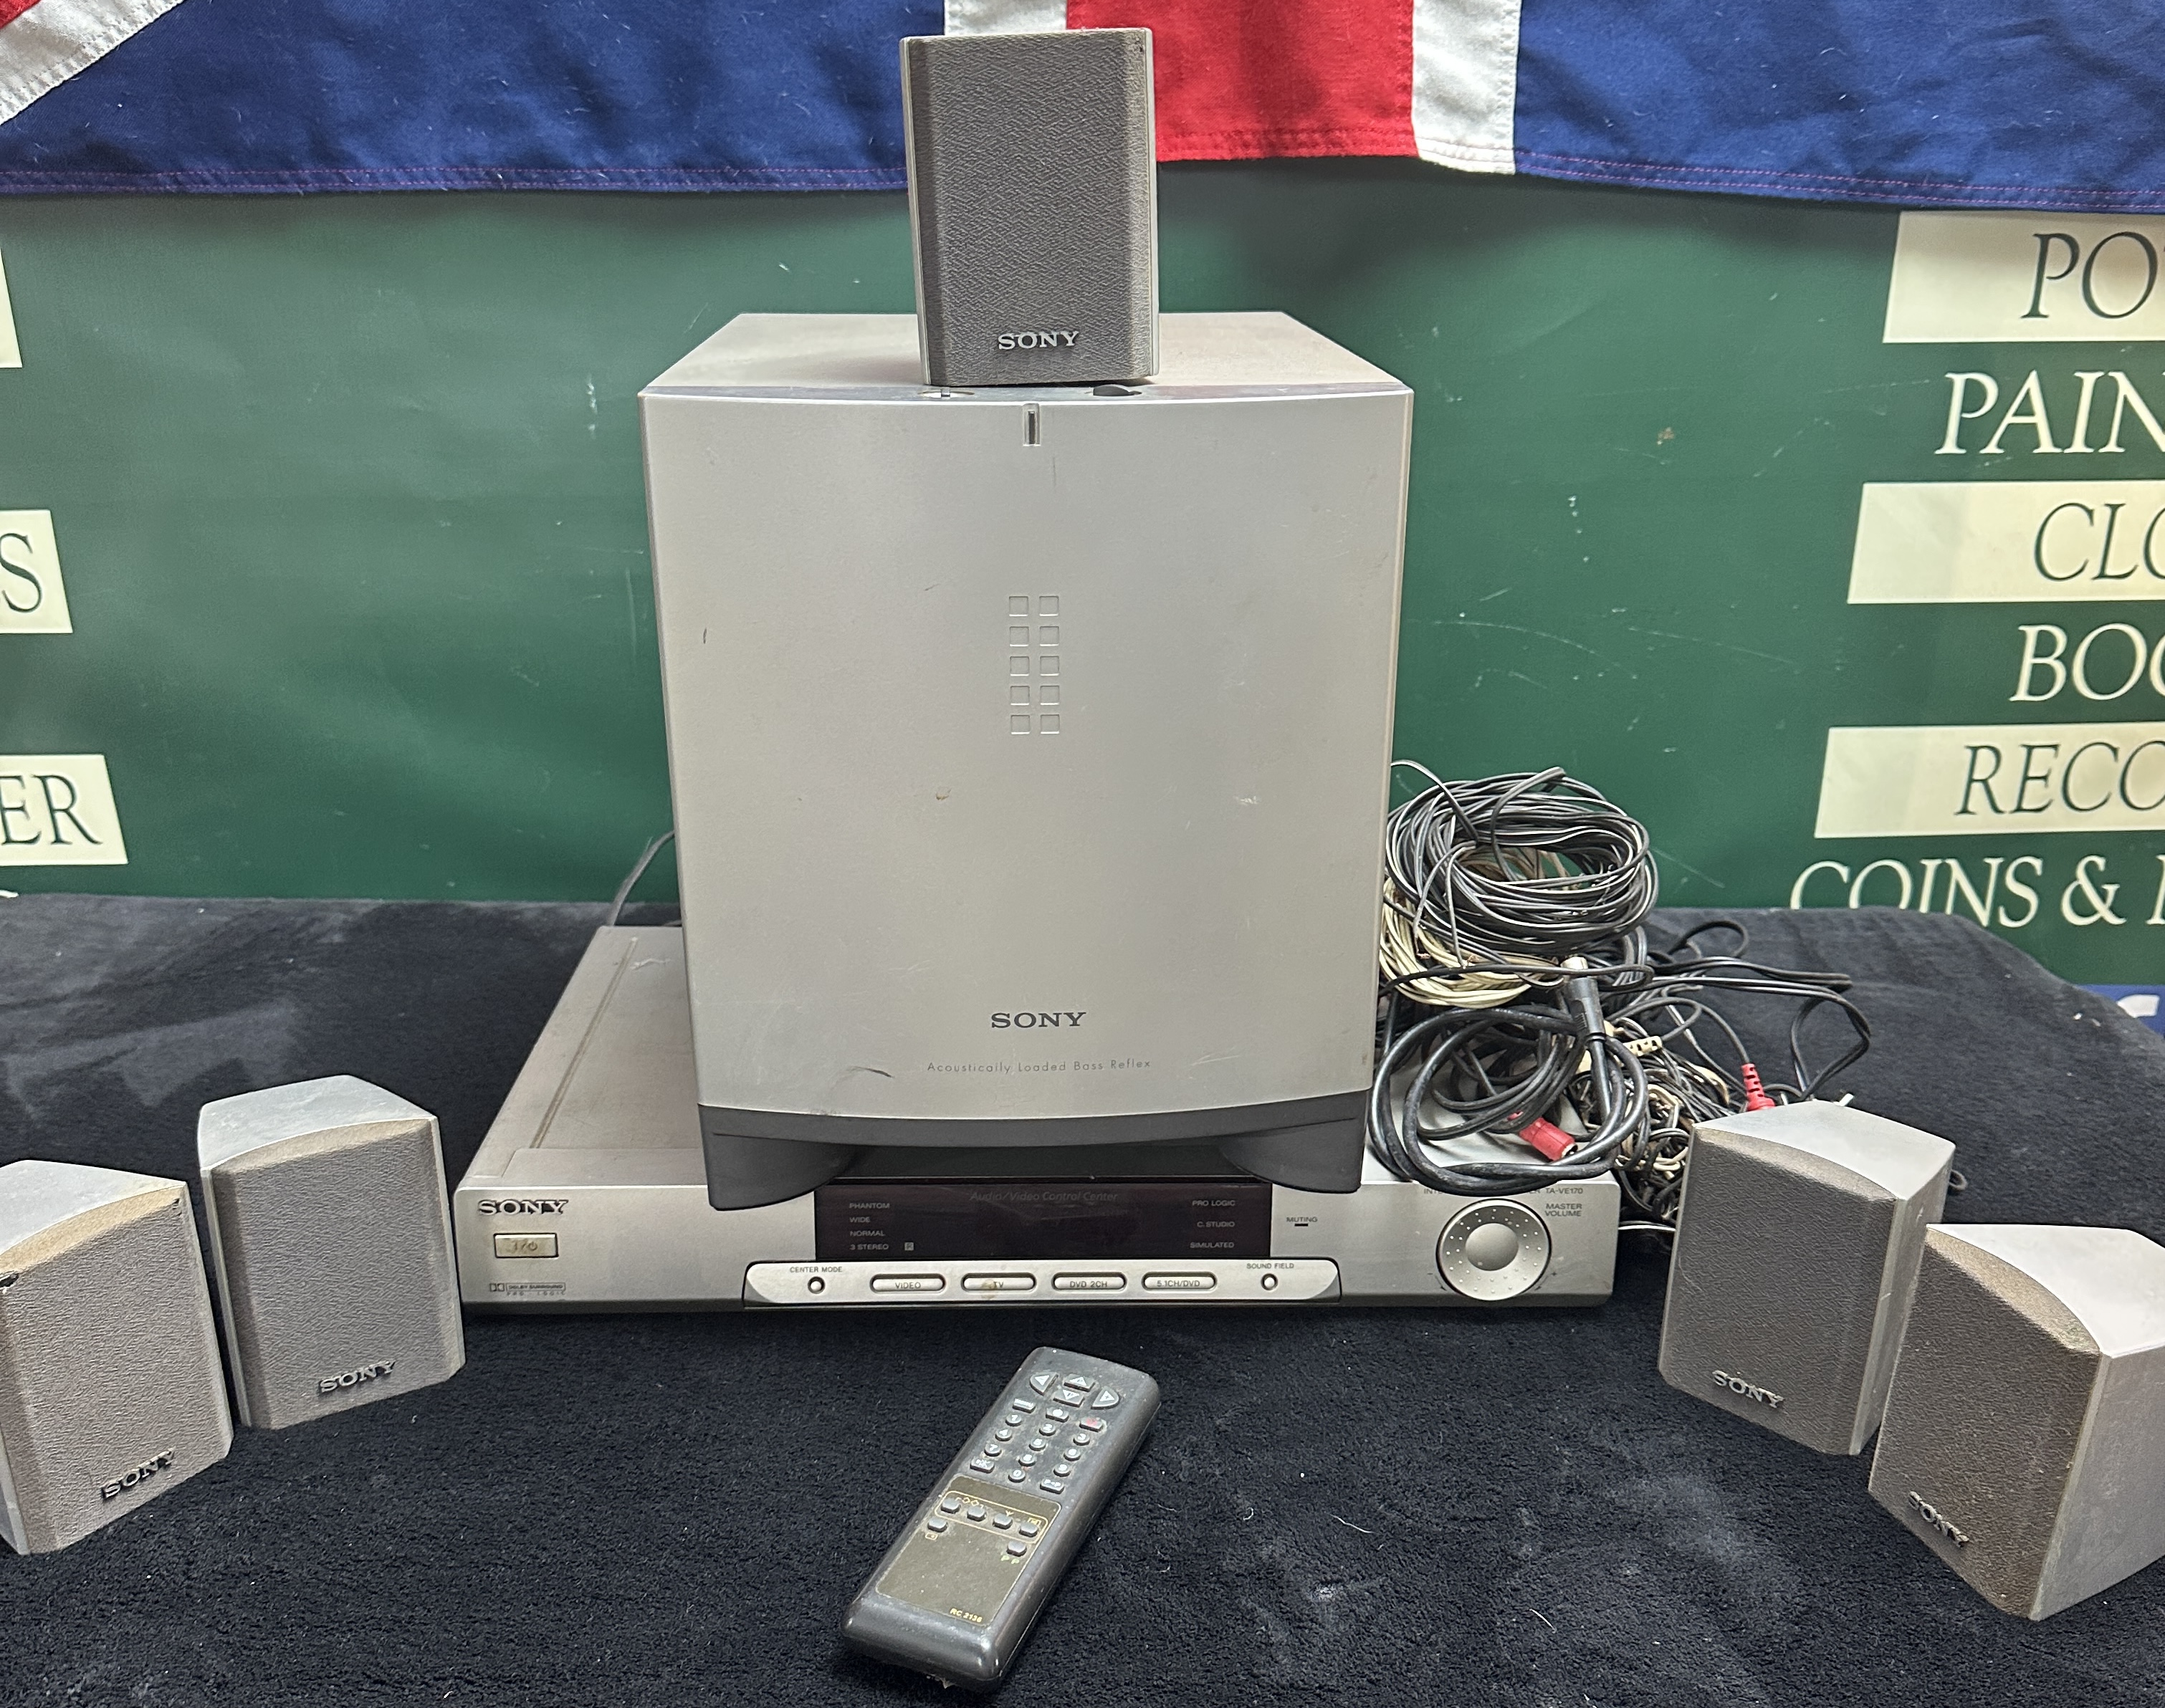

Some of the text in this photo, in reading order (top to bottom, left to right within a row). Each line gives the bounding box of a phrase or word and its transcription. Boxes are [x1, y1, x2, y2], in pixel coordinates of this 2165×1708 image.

[2020, 231, 2165, 319] PO
[998, 330, 1079, 350] SONY
[1934, 370, 2165, 454] PAIN
[2034, 502, 2165, 582] CL
[2009, 623, 2165, 701] BO
[1954, 741, 2165, 815] RECO
[1790, 855, 2043, 928] COINS
[2061, 855, 2126, 926] &
[991, 1012, 1087, 1029] SONY
[927, 1058, 1151, 1075] Acoustically Loaded Bass Reflex
[477, 1199, 568, 1215] SONY
[1157, 1279, 1200, 1287] 5.1CH/DVD
[318, 1360, 396, 1393] SONY
[1712, 1370, 1784, 1409] SONY
[101, 1447, 176, 1500] SONY
[950, 1608, 963, 1616] RC
